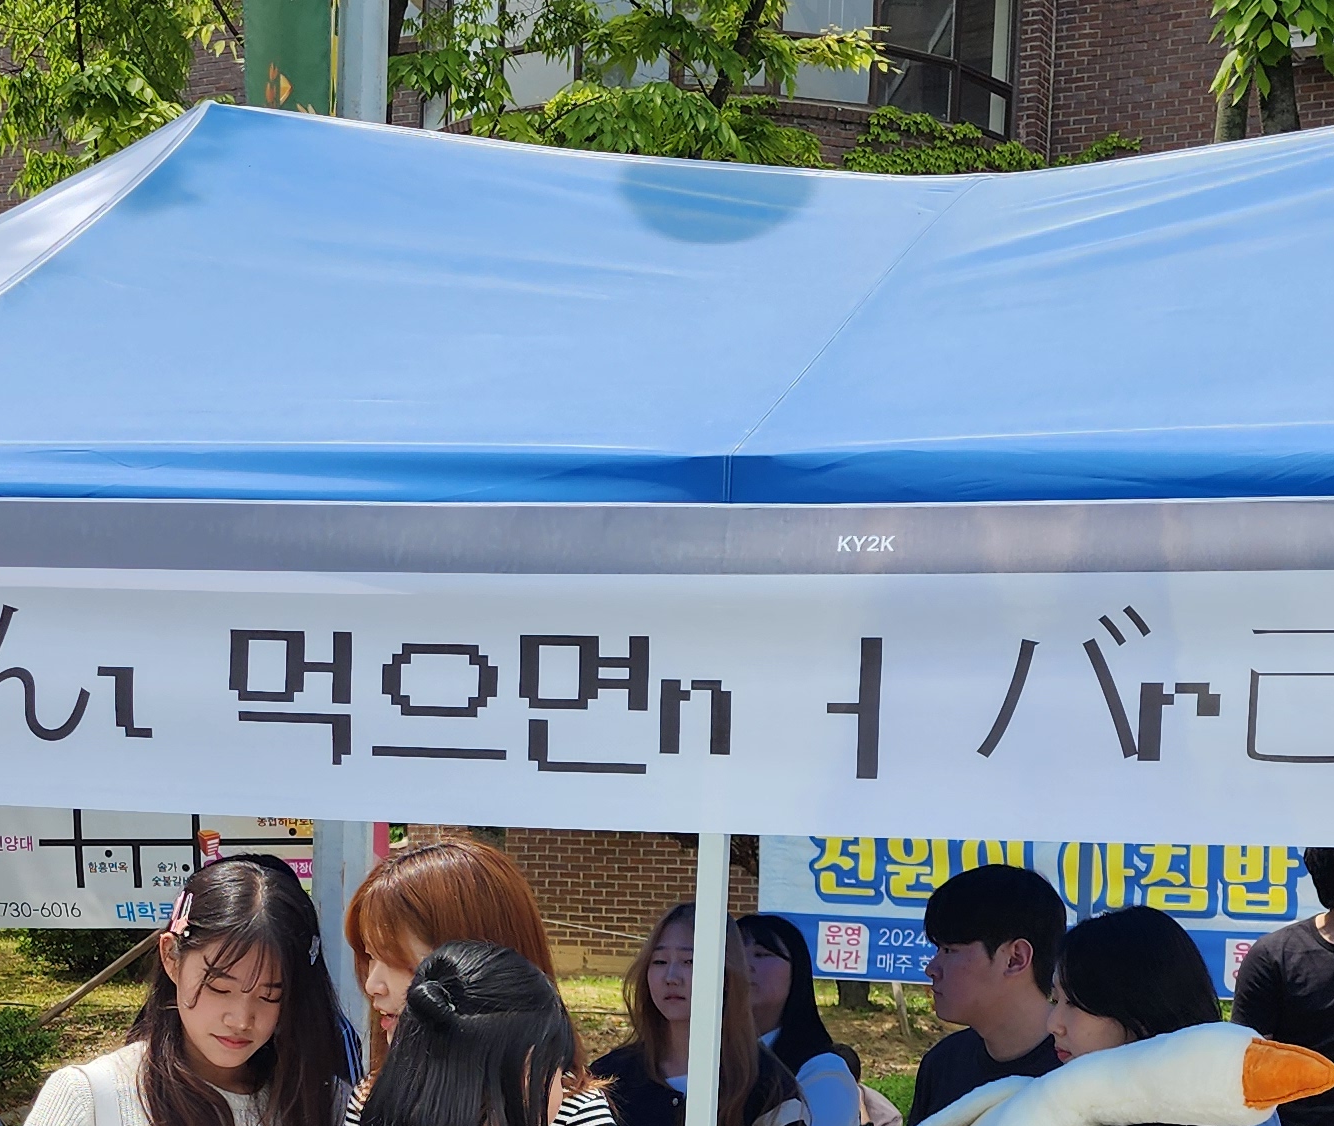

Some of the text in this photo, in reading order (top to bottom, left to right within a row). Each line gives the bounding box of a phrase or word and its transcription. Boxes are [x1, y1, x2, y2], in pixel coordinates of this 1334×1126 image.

[837, 535, 896, 552] KY2K
[825, 925, 862, 946] 운영
[823, 949, 861, 970] 시간
[876, 953, 913, 974] 매주
